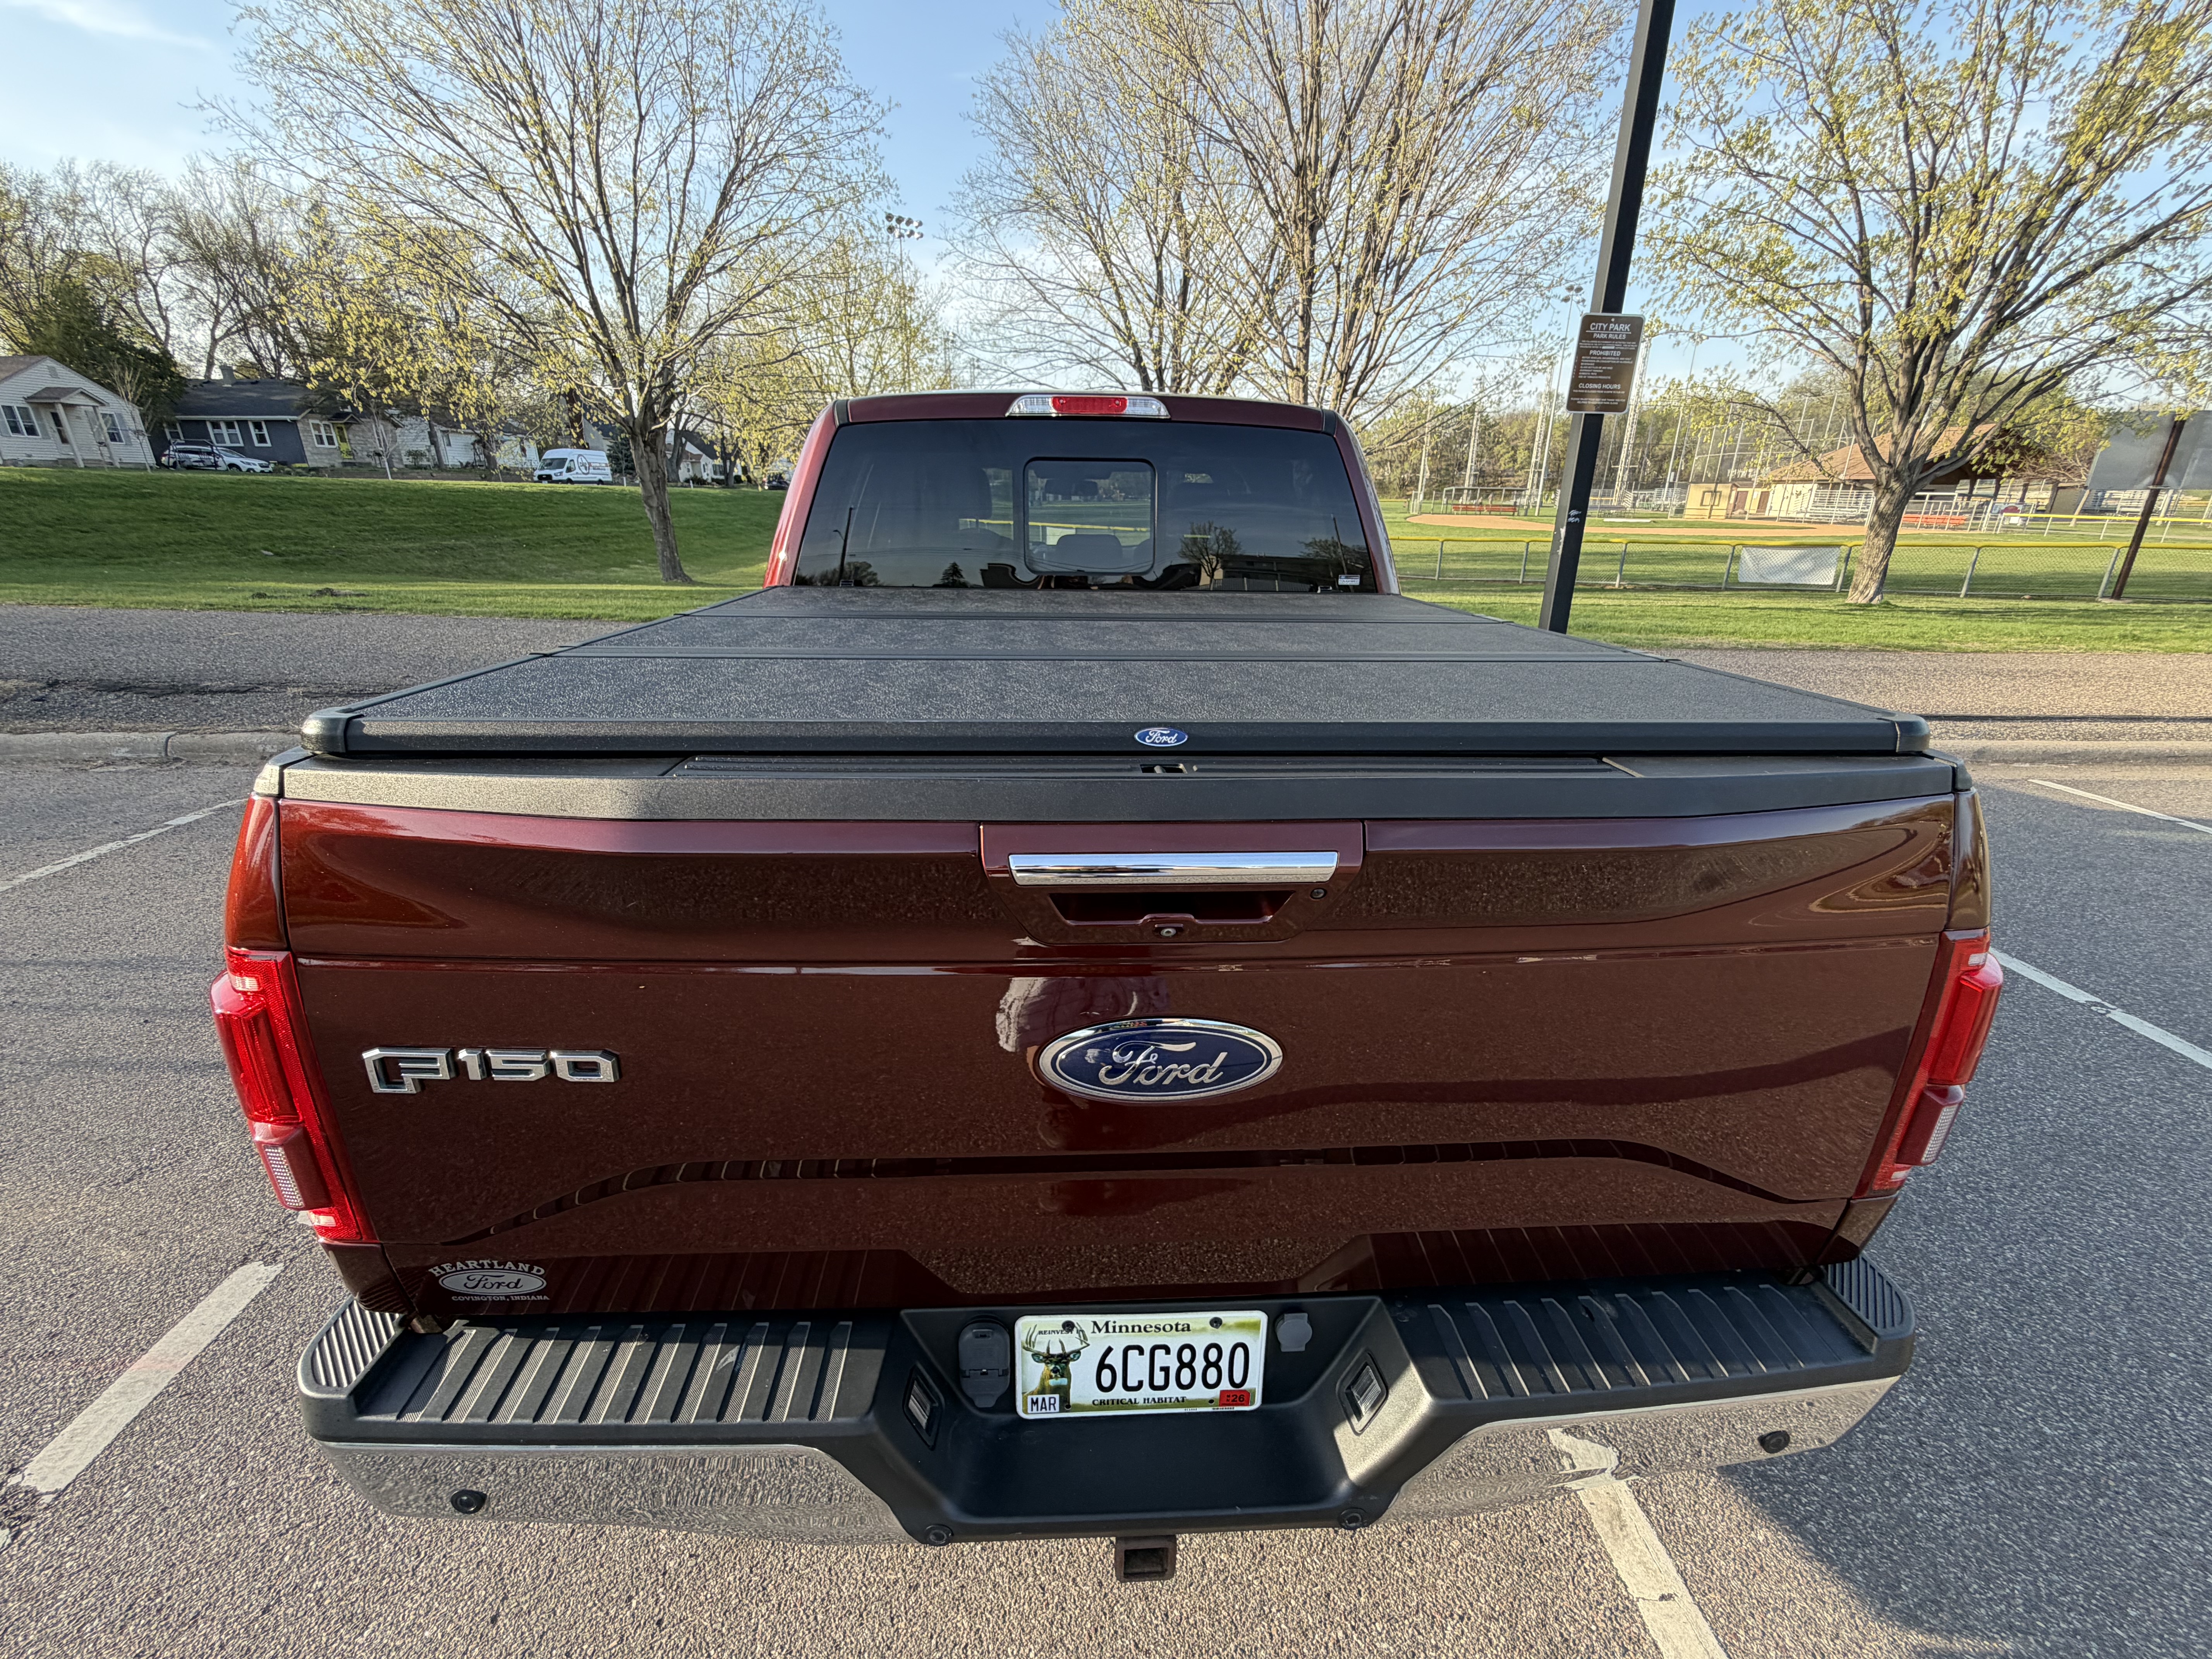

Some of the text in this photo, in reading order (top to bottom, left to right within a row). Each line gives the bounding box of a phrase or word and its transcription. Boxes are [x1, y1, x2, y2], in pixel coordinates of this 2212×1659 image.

[1146, 730, 1178, 743] Ford
[1098, 1041, 1228, 1085] Ford
[428, 1260, 545, 1277] HEARTLAND
[464, 1274, 523, 1289] Ford
[1092, 1321, 1191, 1334] Minnesota
[1096, 1342, 1249, 1392] 6CG880
[1031, 1397, 1056, 1412] MAR
[1092, 1396, 1186, 1406] CRITICAL HABITAT
